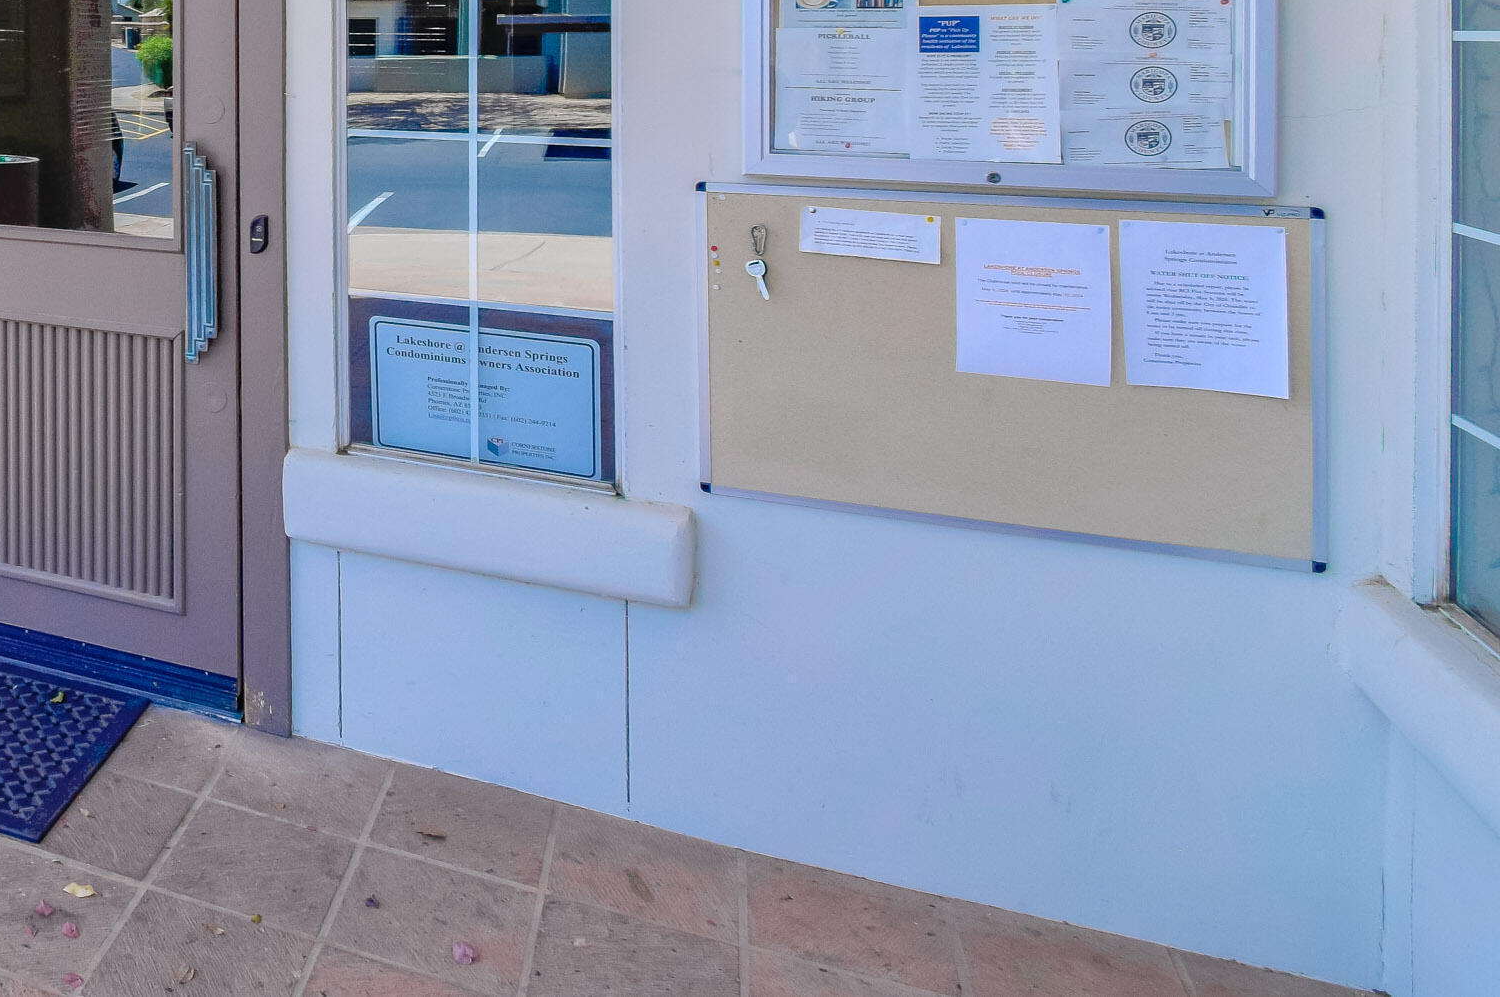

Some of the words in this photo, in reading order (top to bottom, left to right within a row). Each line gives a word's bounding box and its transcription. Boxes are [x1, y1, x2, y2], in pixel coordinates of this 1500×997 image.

[386, 347, 466, 364] Condominiums
[479, 360, 512, 370] wners
[516, 363, 580, 378] Association
[396, 335, 451, 349] Lakeshore
[454, 342, 465, 353] @
[478, 346, 521, 358] ndersen
[524, 349, 568, 363] Springs
